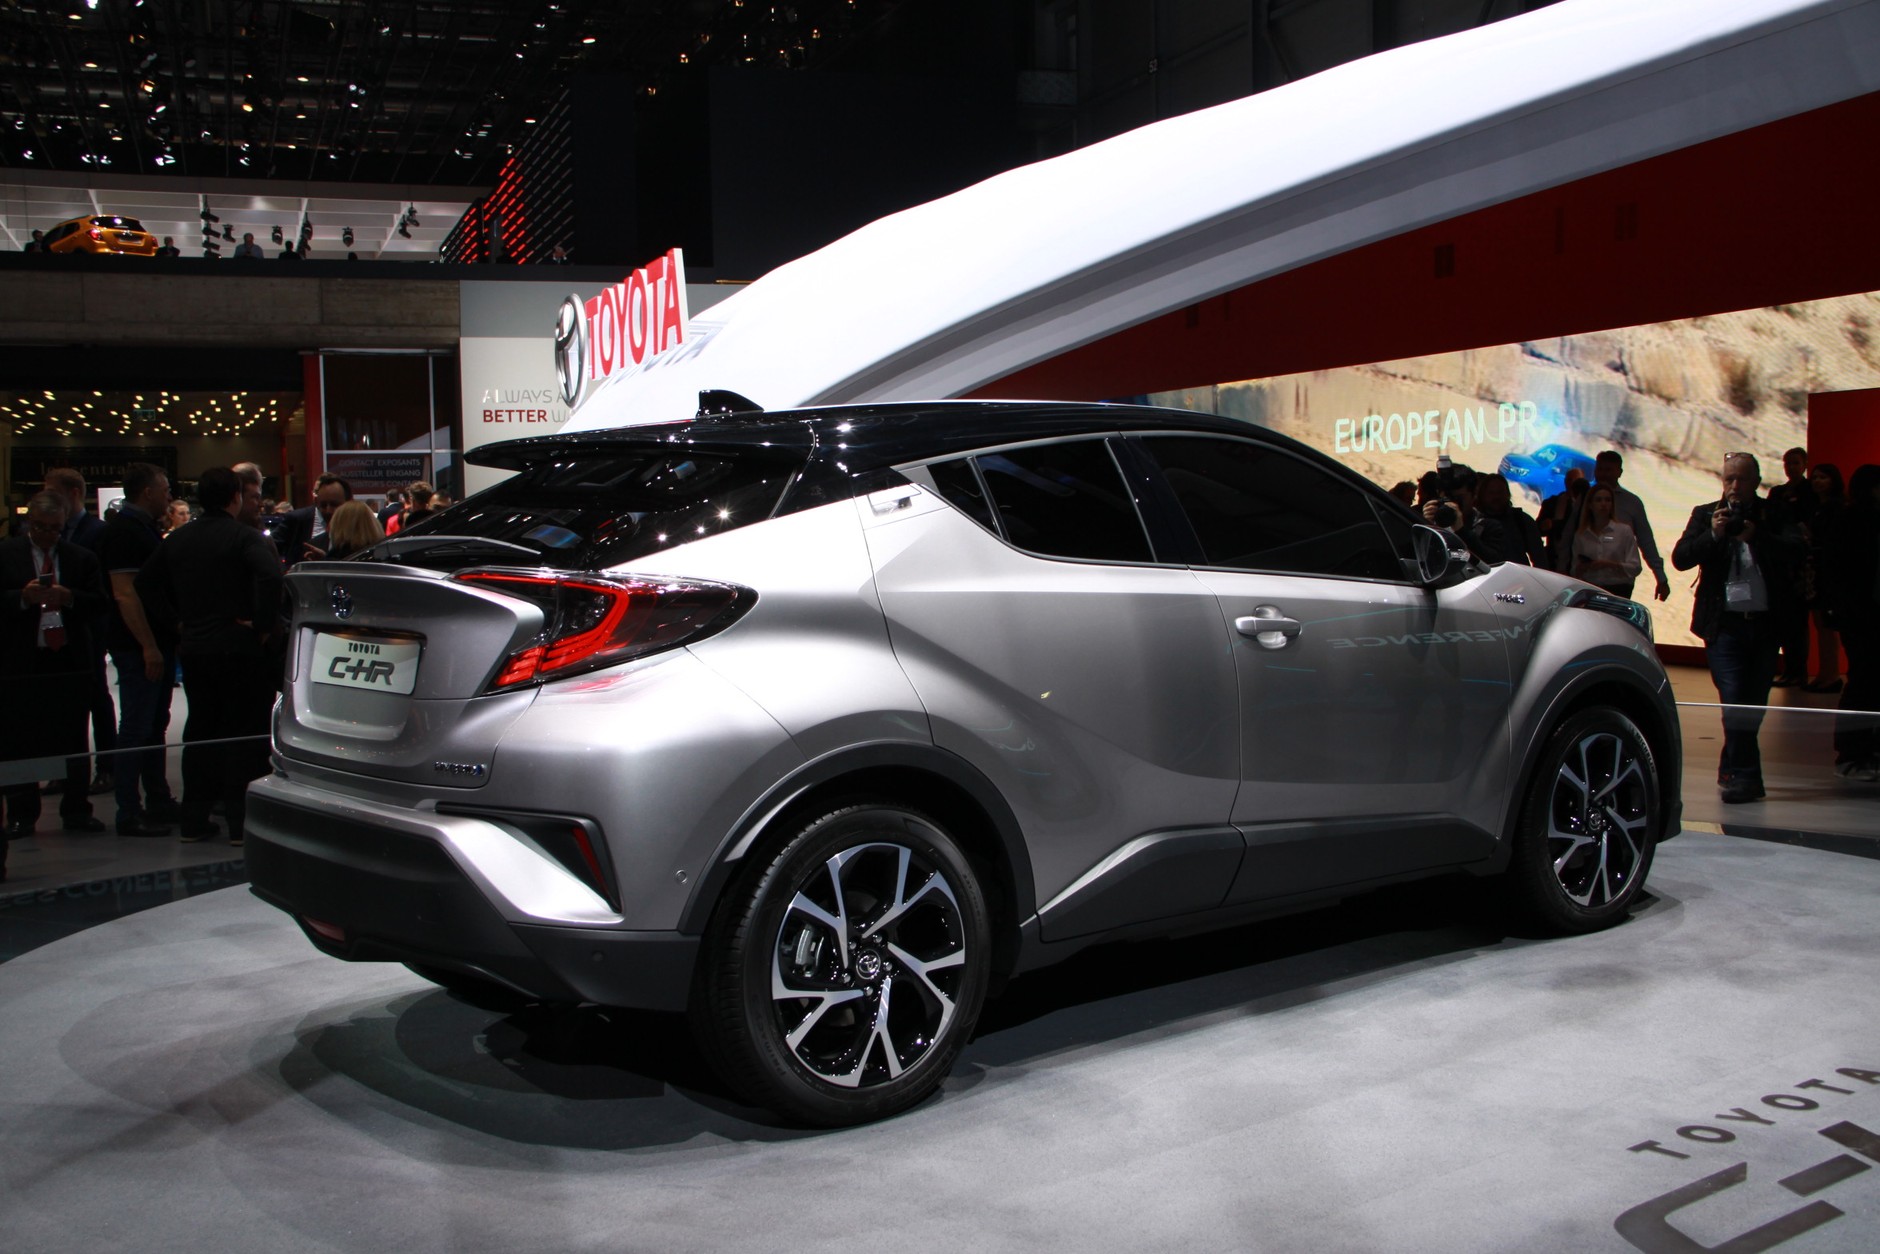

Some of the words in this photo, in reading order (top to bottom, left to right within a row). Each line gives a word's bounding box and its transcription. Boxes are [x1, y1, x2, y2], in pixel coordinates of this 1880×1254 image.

[584, 248, 689, 380] TOYOTA
[482, 389, 552, 403] ALWAYS
[483, 409, 547, 422] BETTER
[1335, 406, 1485, 454] EUROPEAN
[1498, 401, 1538, 444] PR
[377, 458, 421, 466] EXPOSANTS
[386, 469, 421, 477] EINGANG
[348, 642, 380, 655] TOYOTA
[328, 656, 395, 686] C-HR
[1626, 1067, 1880, 1160] TOYOTA
